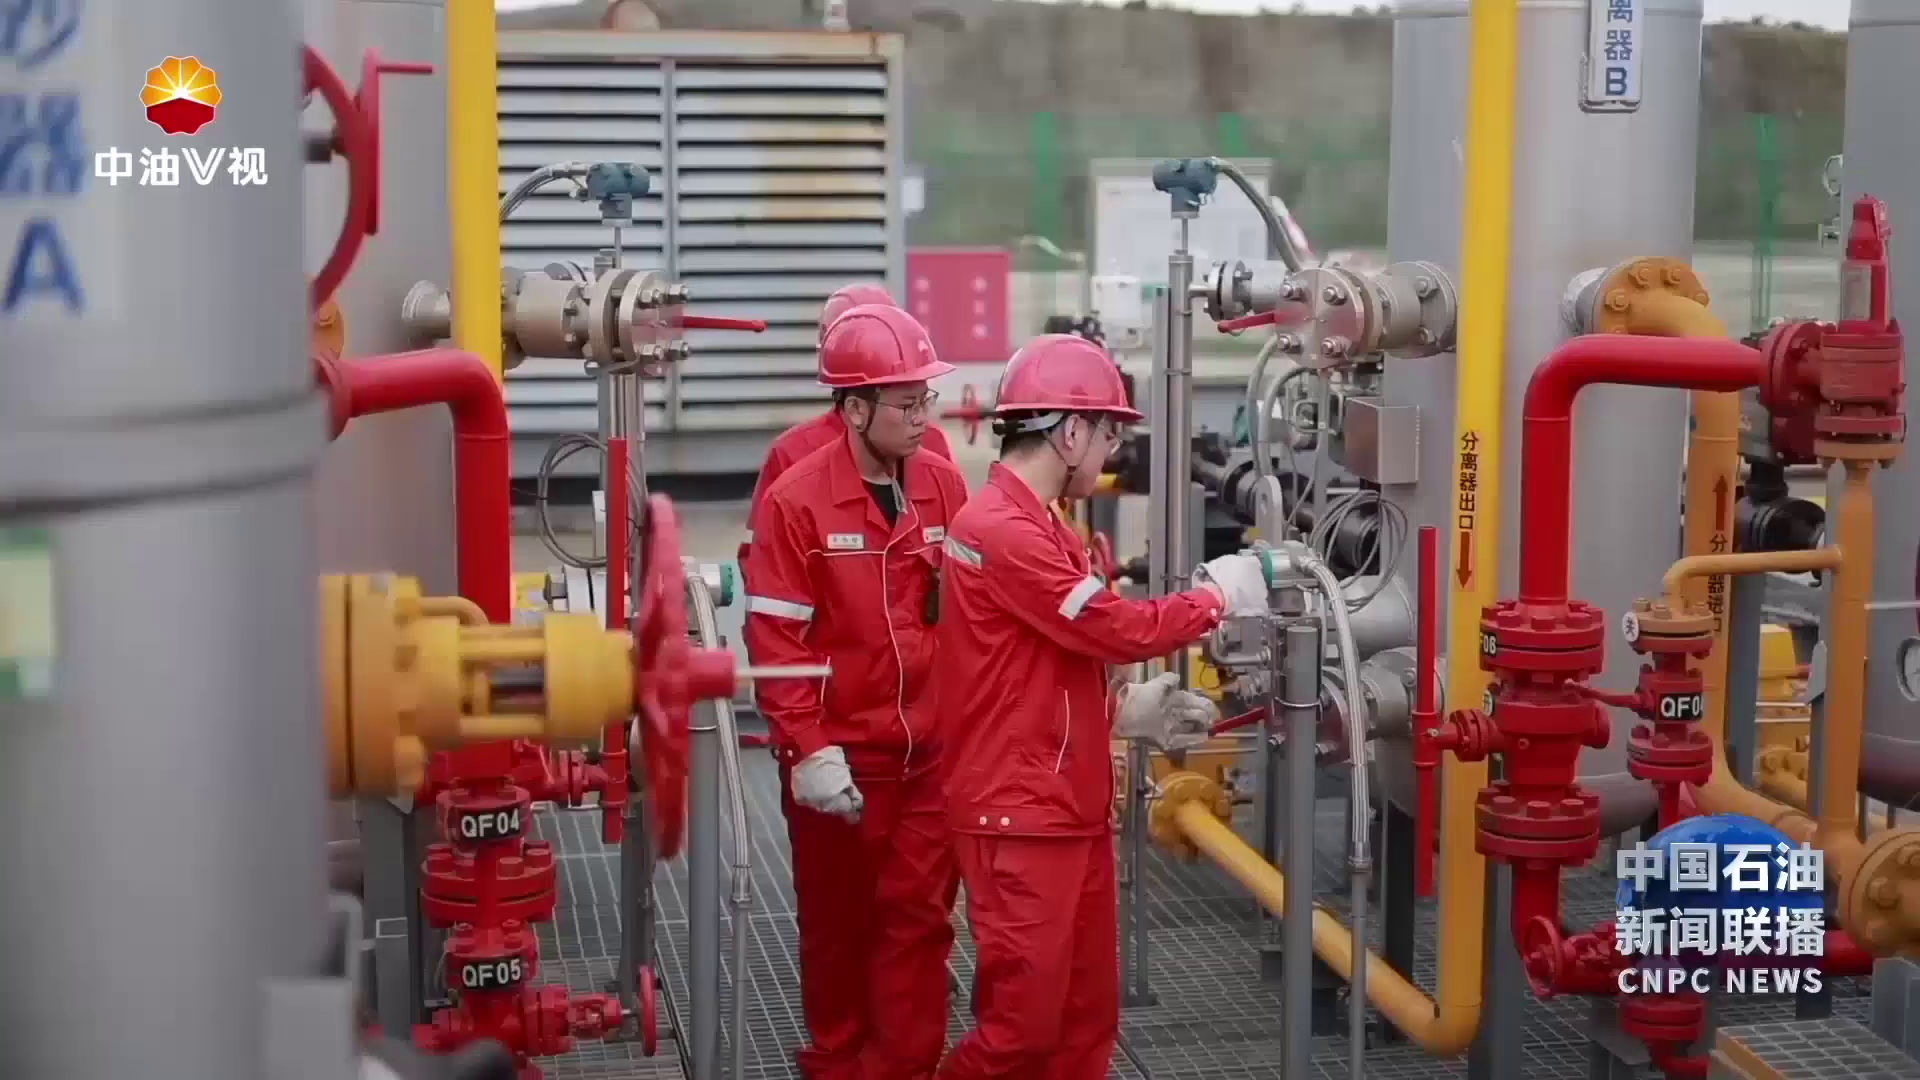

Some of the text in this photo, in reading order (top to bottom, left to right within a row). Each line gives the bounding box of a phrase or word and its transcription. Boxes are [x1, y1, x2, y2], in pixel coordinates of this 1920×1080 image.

[1459, 431, 1479, 530] 分离器出口
[1661, 696, 1704, 718] QF0
[461, 808, 520, 838] QF04
[462, 958, 521, 988] QF05
